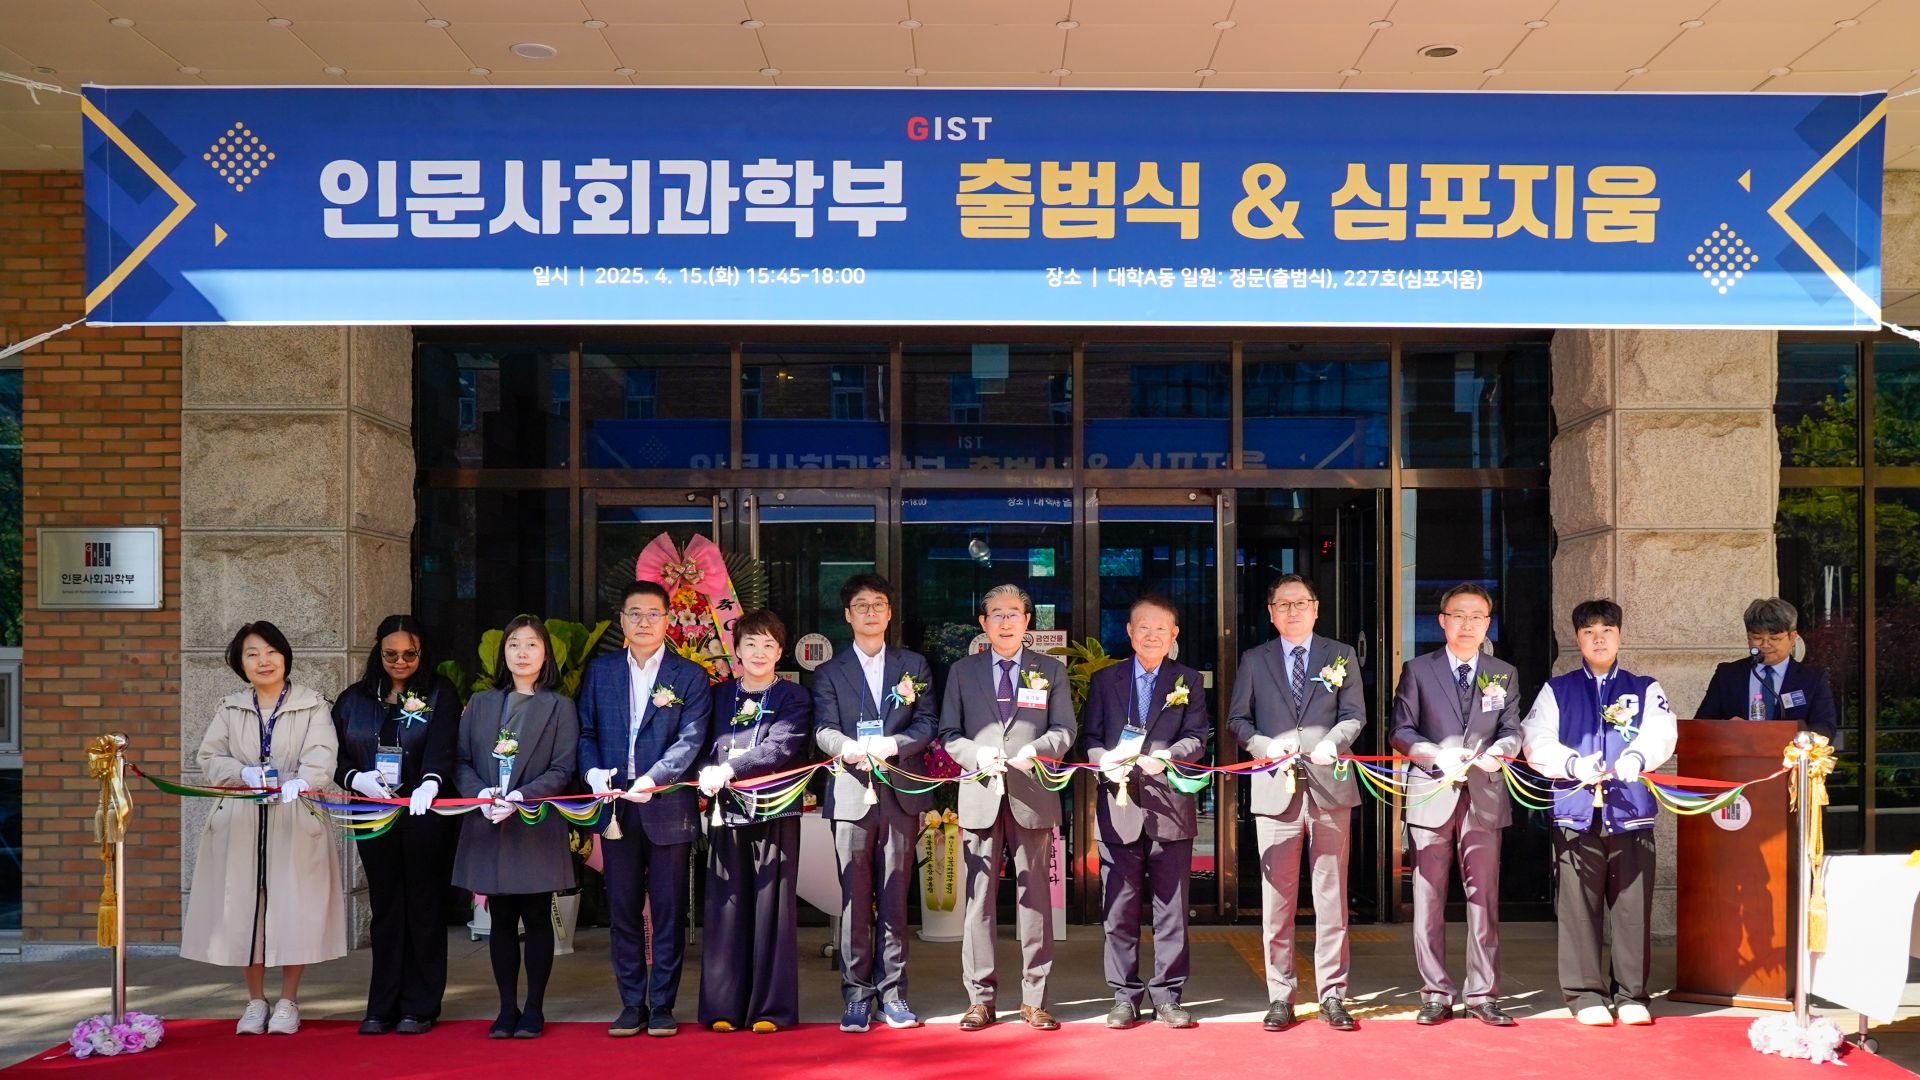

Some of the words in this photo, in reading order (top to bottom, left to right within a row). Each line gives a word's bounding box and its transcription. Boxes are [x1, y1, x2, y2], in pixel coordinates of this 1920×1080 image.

[907, 116, 993, 141] GIST
[319, 158, 907, 239] 인문사회과학부
[955, 158, 1200, 240] 출범식
[1231, 162, 1305, 240] &
[1331, 163, 1661, 244] 심포지움
[532, 266, 569, 287] 일시
[594, 266, 649, 285] 2025.
[654, 266, 673, 285] 4.
[679, 265, 740, 287] 15.(화)
[746, 266, 866, 285] 15:45-18:00
[1045, 267, 1082, 288] 장소
[1107, 267, 1176, 289] 대학A동
[1181, 267, 1223, 288] 일원:
[1229, 267, 1339, 290] 정문(출범식),
[1343, 268, 1483, 290] 227호(심포지움)
[85, 543, 111, 567] GIST
[62, 574, 135, 584] 인문사회과학부
